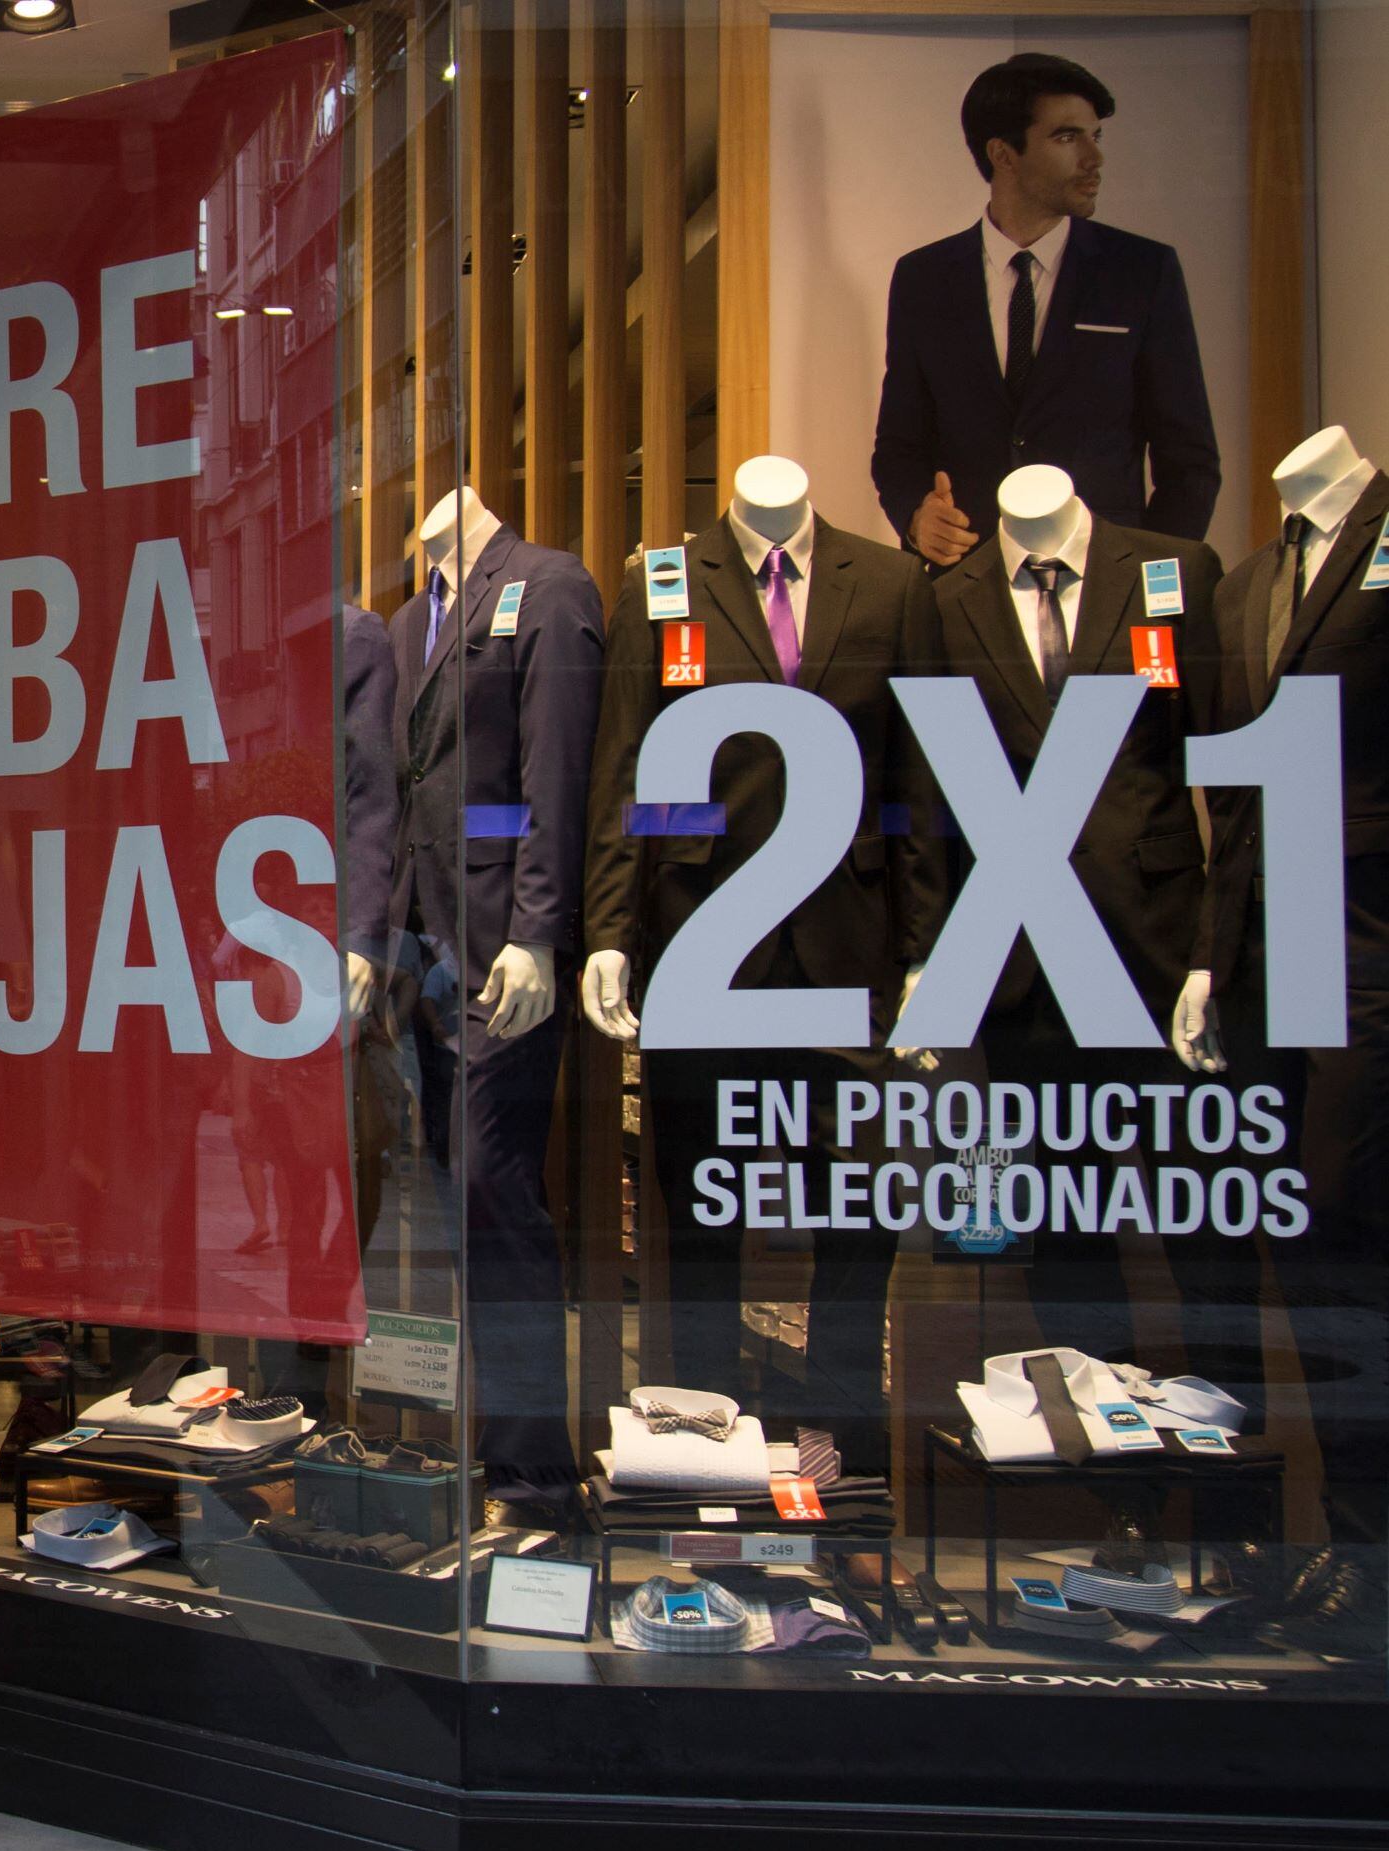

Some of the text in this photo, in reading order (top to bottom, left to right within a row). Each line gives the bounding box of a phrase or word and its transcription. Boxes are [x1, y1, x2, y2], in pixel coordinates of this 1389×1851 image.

[667, 664, 701, 681] 2X1
[636, 675, 1348, 1049] 2X1
[717, 1080, 1288, 1154] EN PRODUCTOS
[955, 1144, 1013, 1168] AMBO
[692, 1159, 1311, 1238] SELECCIONADOS
[375, 1319, 441, 1336] ACCESORIOS
[784, 1509, 822, 1519] 2X1
[760, 1544, 794, 1556] $249
[845, 1669, 1269, 1691] MACOWENS
